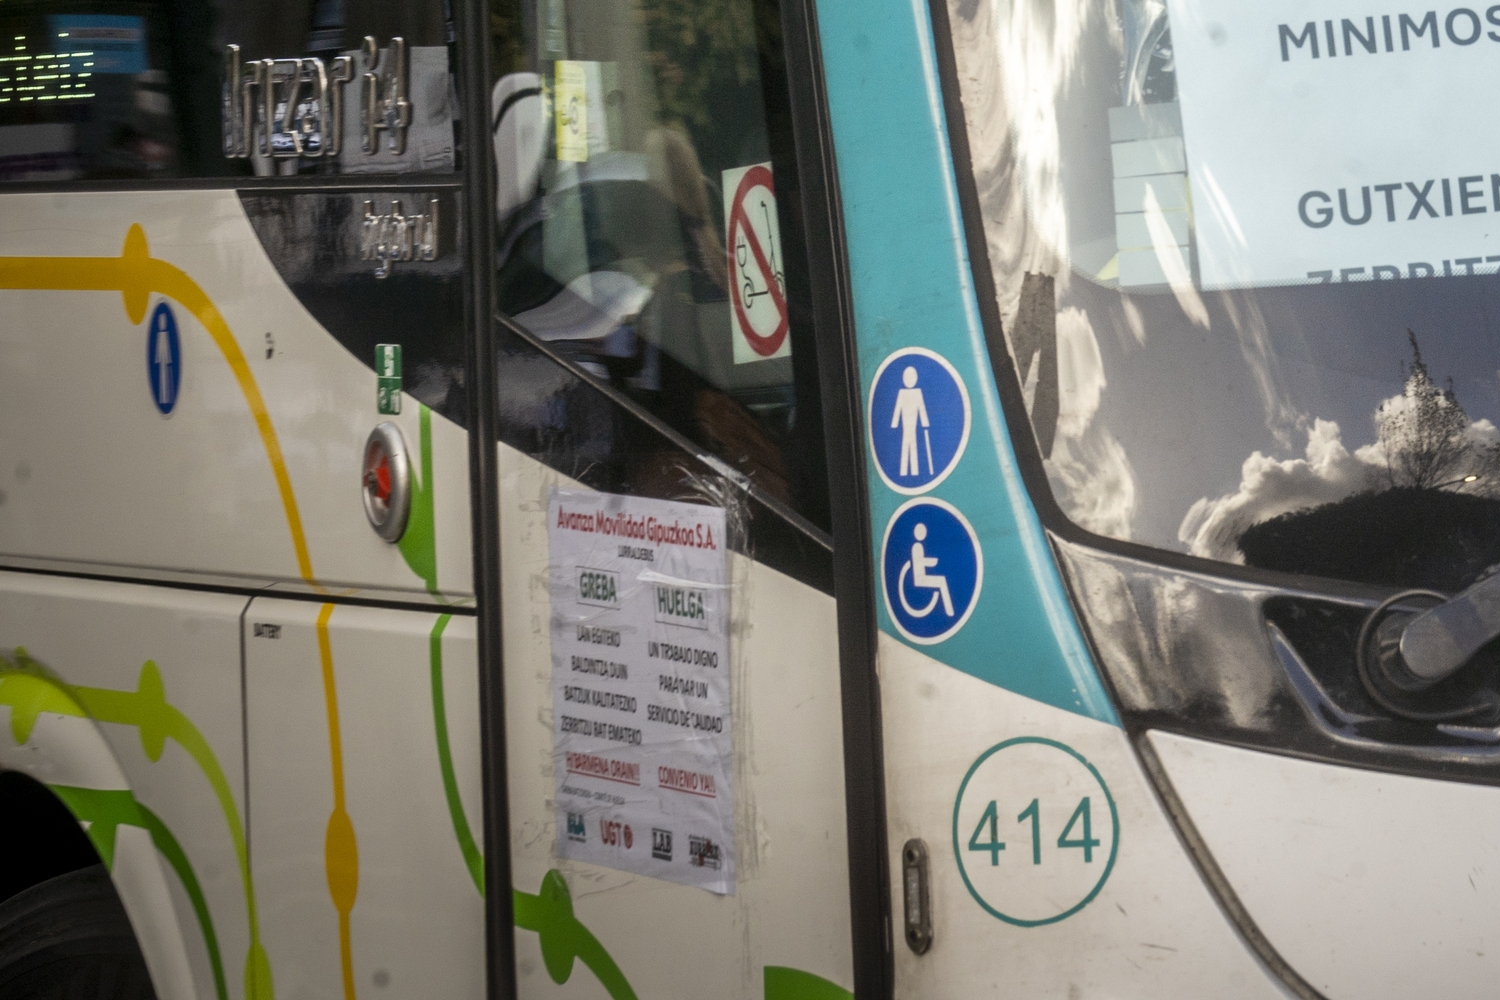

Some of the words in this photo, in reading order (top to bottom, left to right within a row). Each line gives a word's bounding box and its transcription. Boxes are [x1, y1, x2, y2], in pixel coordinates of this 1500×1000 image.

[222, 43, 351, 158] Irizar
[557, 505, 594, 532] Avanza
[595, 511, 645, 541] Movilidad
[646, 516, 695, 547] Gipuzkoa
[696, 523, 716, 550] S.A.
[579, 571, 617, 603] GREBA
[656, 586, 705, 620] HUELGA
[660, 643, 692, 664] TRABAJO
[647, 703, 679, 726] SERVICIO
[658, 765, 698, 790] CONVENIO
[600, 818, 621, 848] UGT
[652, 830, 672, 854] LAB
[968, 796, 1100, 867] 414
